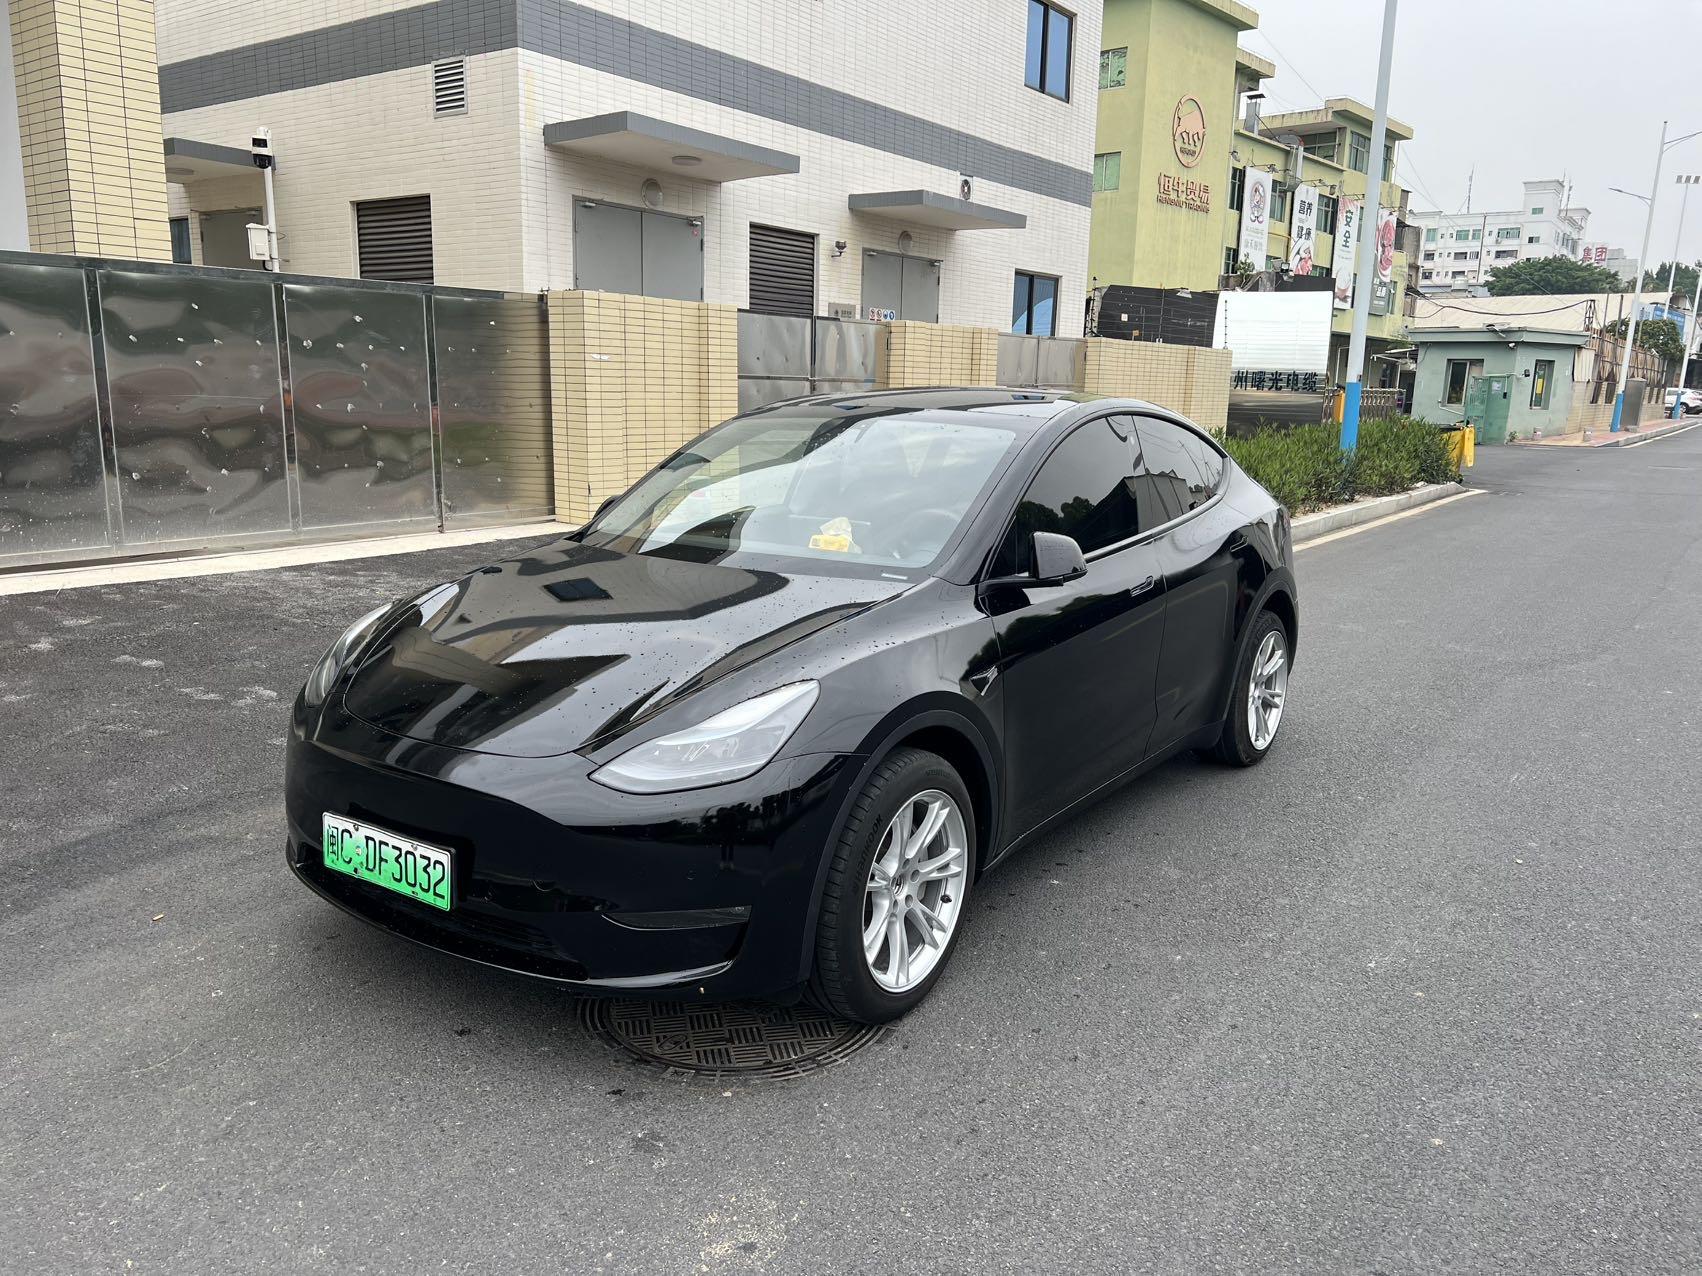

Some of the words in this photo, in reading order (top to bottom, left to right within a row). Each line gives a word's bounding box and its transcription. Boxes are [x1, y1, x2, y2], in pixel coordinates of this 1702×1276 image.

[1159, 173, 1210, 205] 恒牛贸易
[1184, 200, 1210, 214] TRADING
[1299, 200, 1313, 216] 营养
[1297, 226, 1311, 240] 健康
[1342, 210, 1354, 248] 安全
